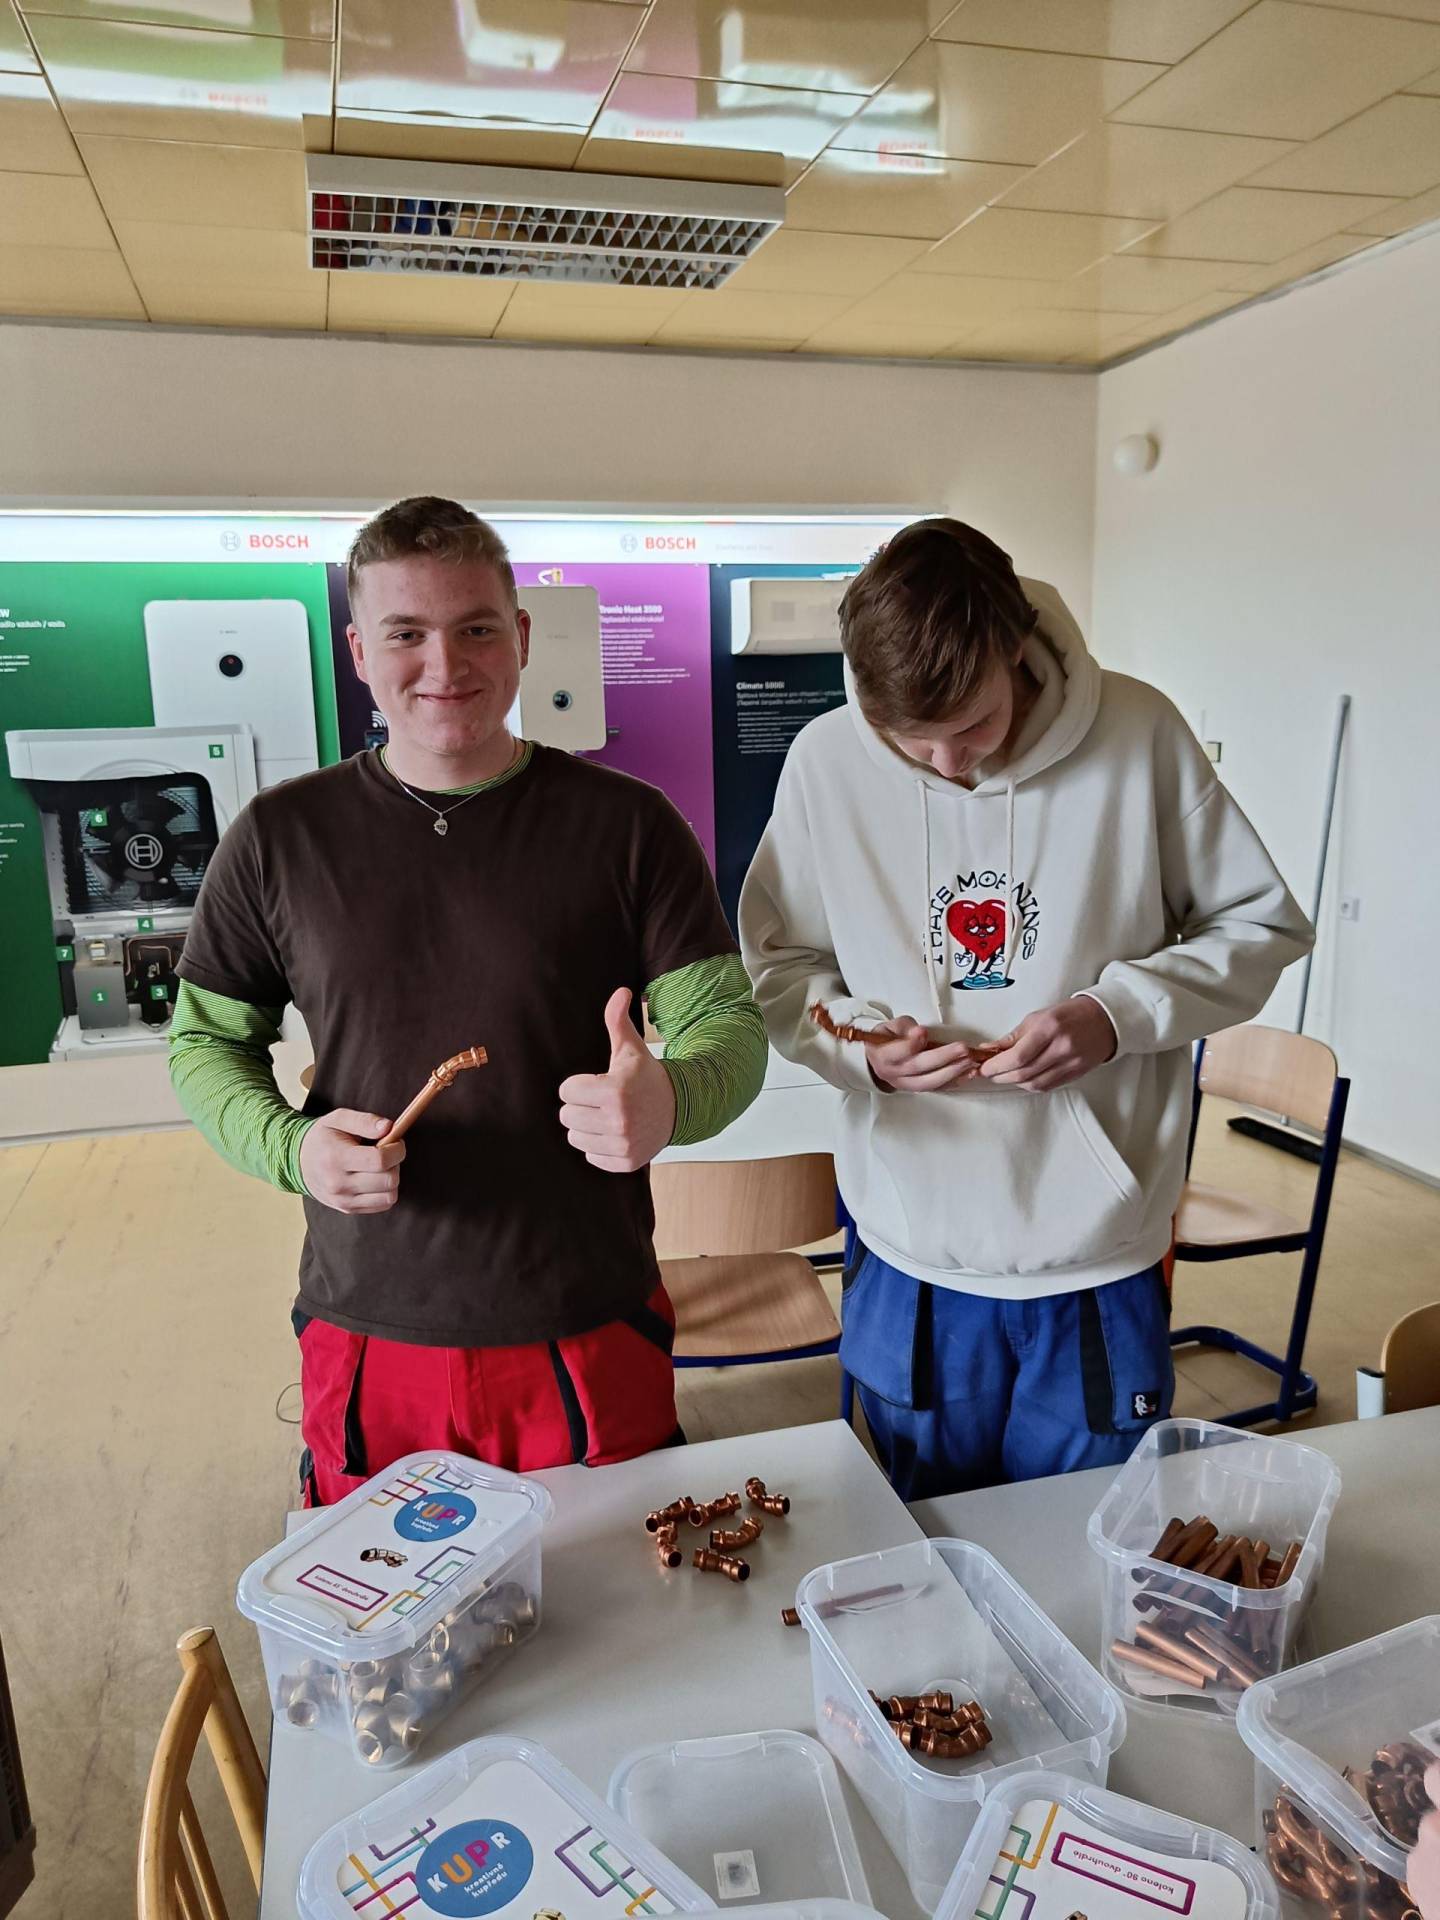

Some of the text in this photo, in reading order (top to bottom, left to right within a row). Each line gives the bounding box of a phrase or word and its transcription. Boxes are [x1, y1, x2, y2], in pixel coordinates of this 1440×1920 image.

[250, 534, 309, 548] BOSCH
[645, 536, 696, 550] BOSCH
[412, 1500, 466, 1526] KUPR
[427, 1832, 511, 1893] KUPR
[1073, 1850, 1121, 1873] dvouhrdle
[1141, 1876, 1174, 1894] koleno
